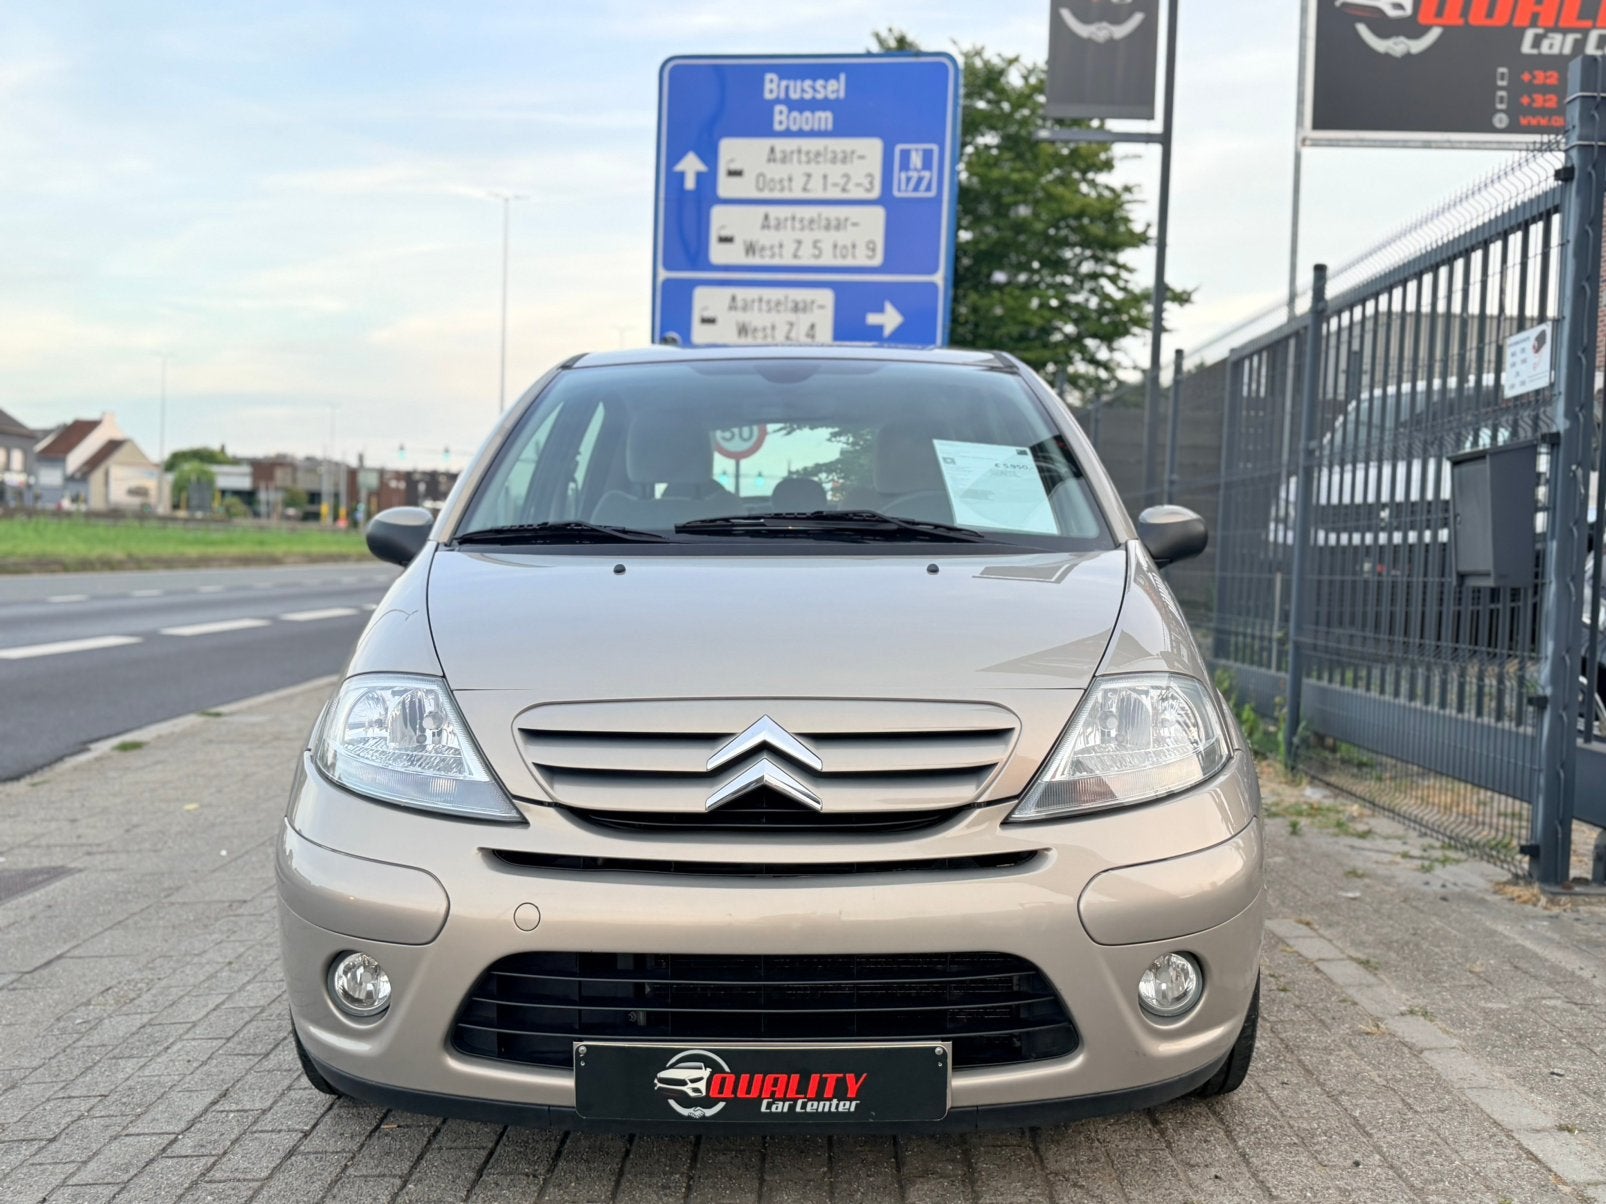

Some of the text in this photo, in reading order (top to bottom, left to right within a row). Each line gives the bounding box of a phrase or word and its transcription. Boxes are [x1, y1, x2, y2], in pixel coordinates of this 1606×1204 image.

[1520, 28, 1582, 55] Car
[763, 72, 846, 100] Brussel
[1521, 70, 1559, 85] +32
[1520, 93, 1558, 109] +32
[772, 104, 833, 131] Boom
[766, 146, 866, 165] Aartselaar-
[909, 150, 923, 170] N
[755, 171, 793, 194] Oost
[822, 171, 875, 194] 1-2-3
[900, 171, 932, 192] 177
[760, 212, 860, 232] Aartselaar-
[743, 239, 785, 260] West
[832, 240, 857, 260] tot
[865, 239, 878, 261] 9
[727, 294, 826, 314] Aartselaar-
[735, 320, 776, 341] West
[804, 322, 817, 342] 4
[709, 1073, 868, 1099] QUALITY
[760, 1099, 861, 1113] Car Center
